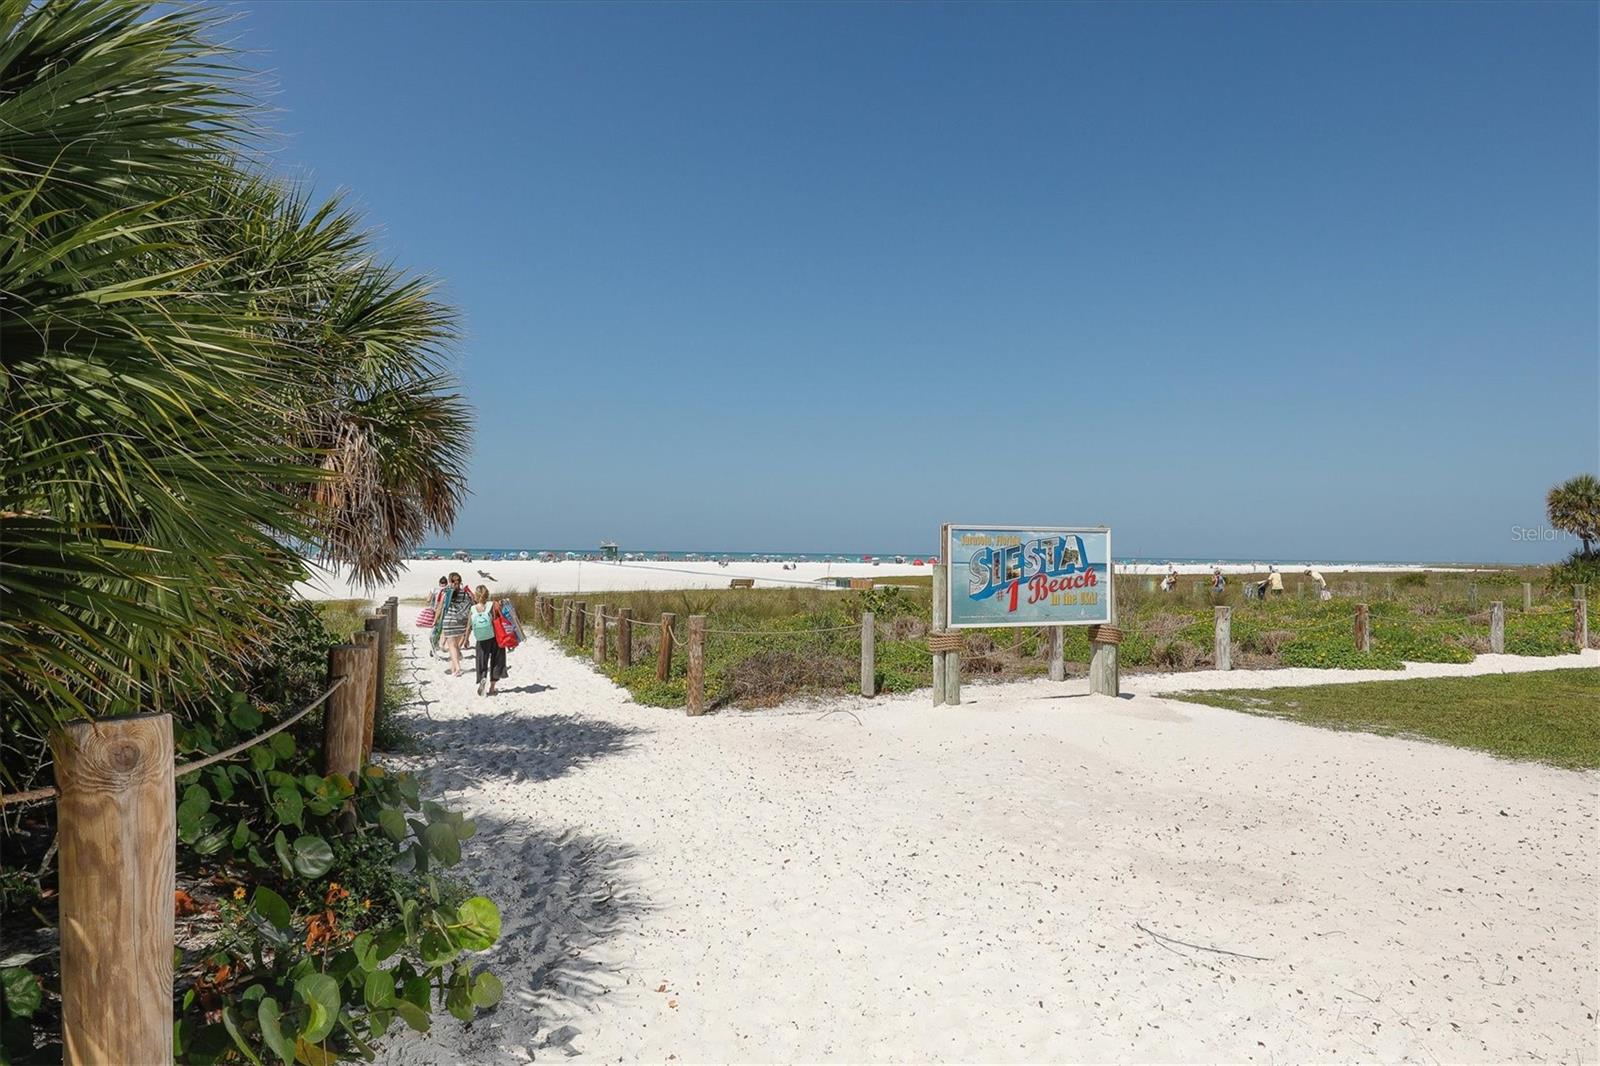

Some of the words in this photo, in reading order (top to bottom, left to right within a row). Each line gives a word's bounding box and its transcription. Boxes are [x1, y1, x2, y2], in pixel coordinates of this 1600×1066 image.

[969, 535, 1088, 601] SIESTA
[996, 579, 1018, 612] #1
[1028, 567, 1097, 605] Beach
